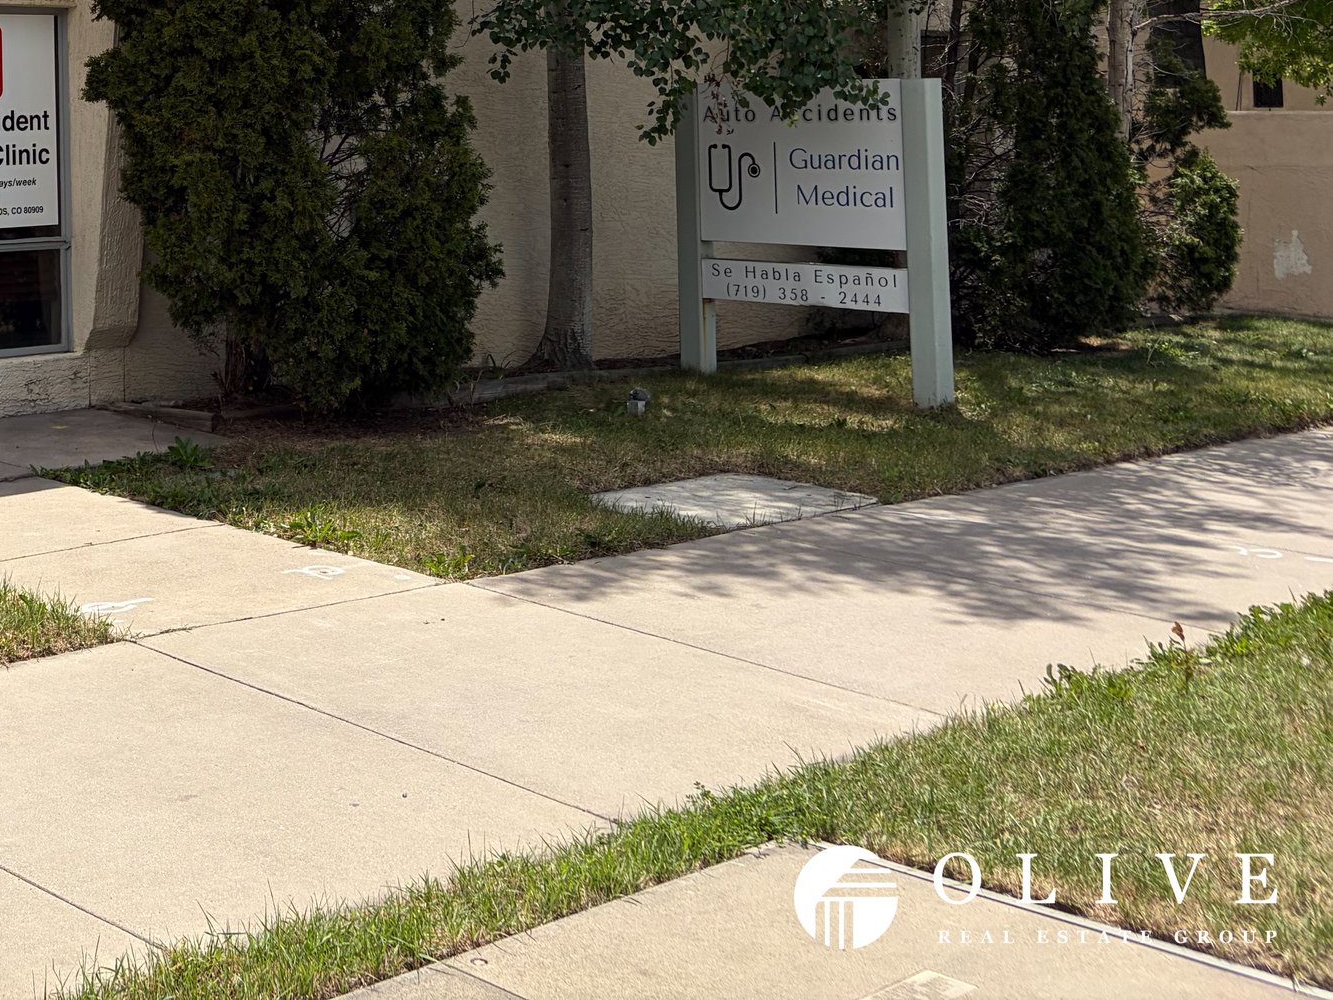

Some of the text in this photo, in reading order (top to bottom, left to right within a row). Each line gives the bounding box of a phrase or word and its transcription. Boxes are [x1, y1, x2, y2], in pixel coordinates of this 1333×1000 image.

[703, 104, 897, 122] Auto Acidents
[789, 148, 899, 171] Guardian
[796, 184, 893, 208] Medical
[11, 207, 22, 215] CO
[24, 206, 43, 214] 80909
[711, 263, 897, 288] Se Habla Español
[726, 283, 766, 300] (719)
[778, 287, 808, 302] 358
[839, 291, 882, 307] 2444
